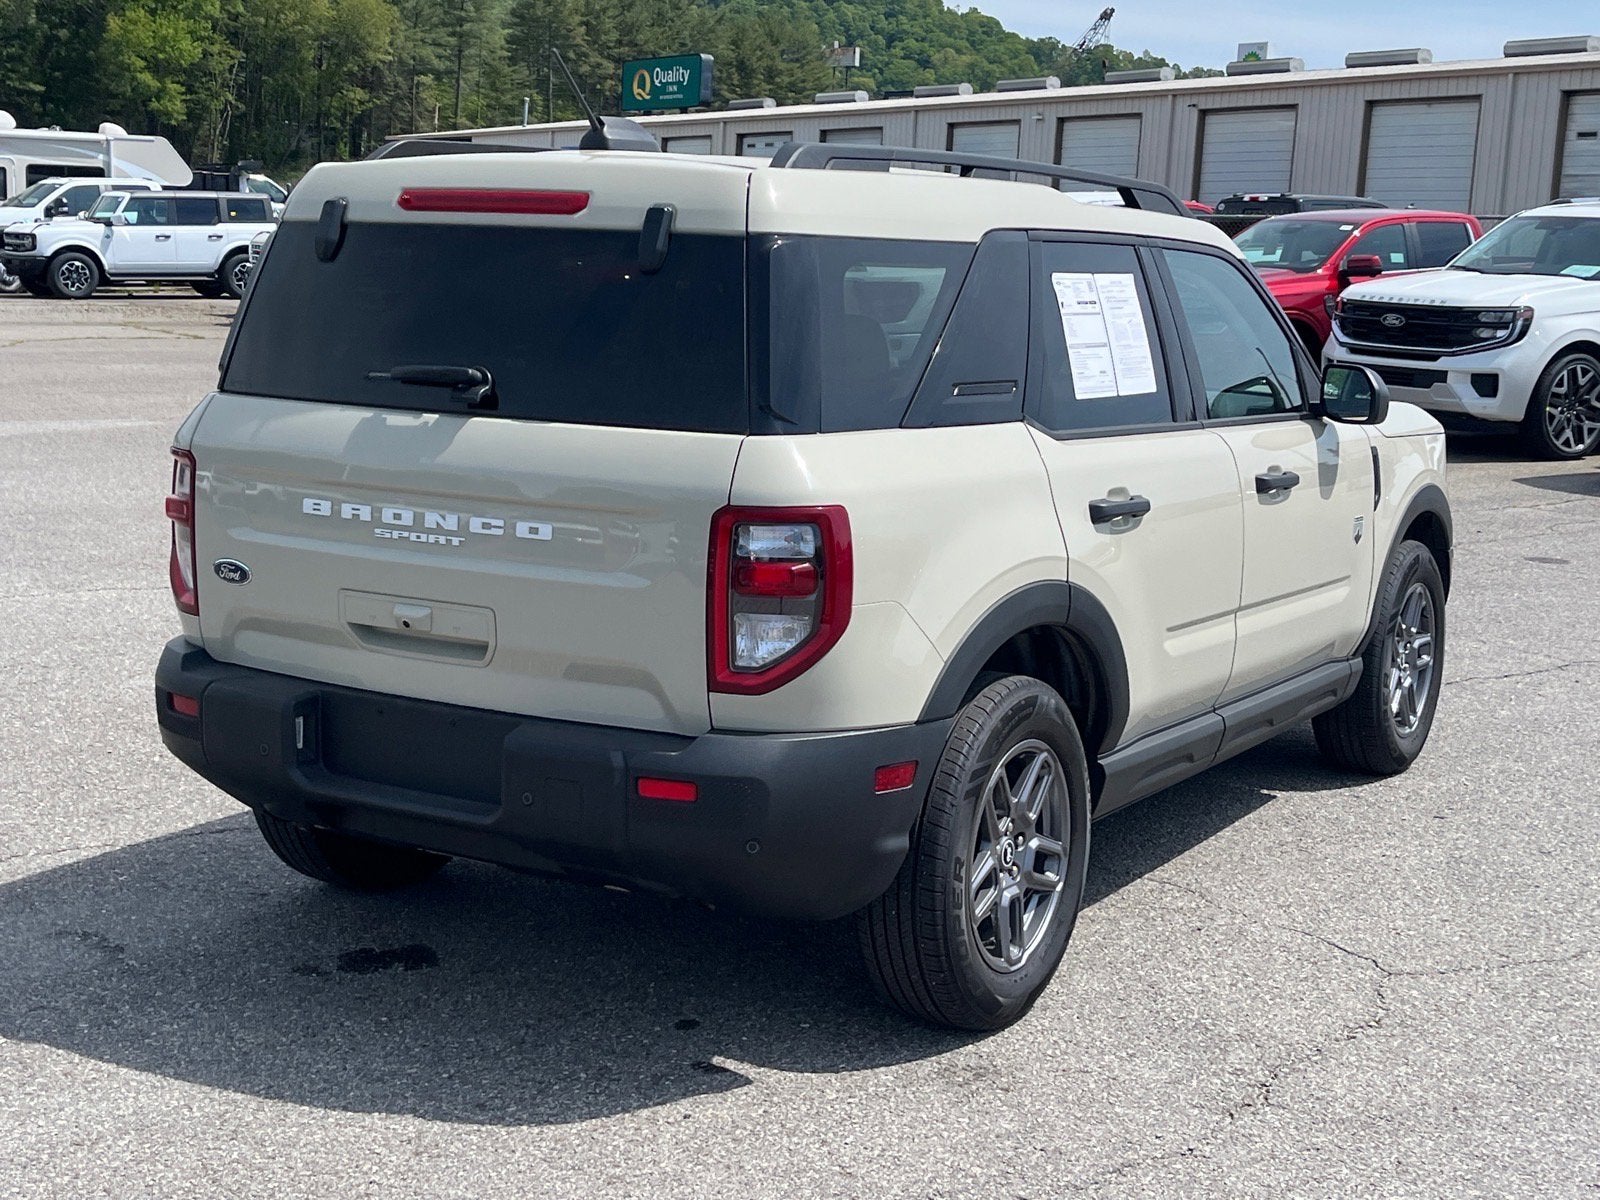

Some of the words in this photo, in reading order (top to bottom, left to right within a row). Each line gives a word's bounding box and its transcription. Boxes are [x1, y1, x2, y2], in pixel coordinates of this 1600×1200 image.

[653, 66, 690, 86] Quality
[302, 497, 554, 541] BRONCO
[374, 528, 466, 546] SPORT
